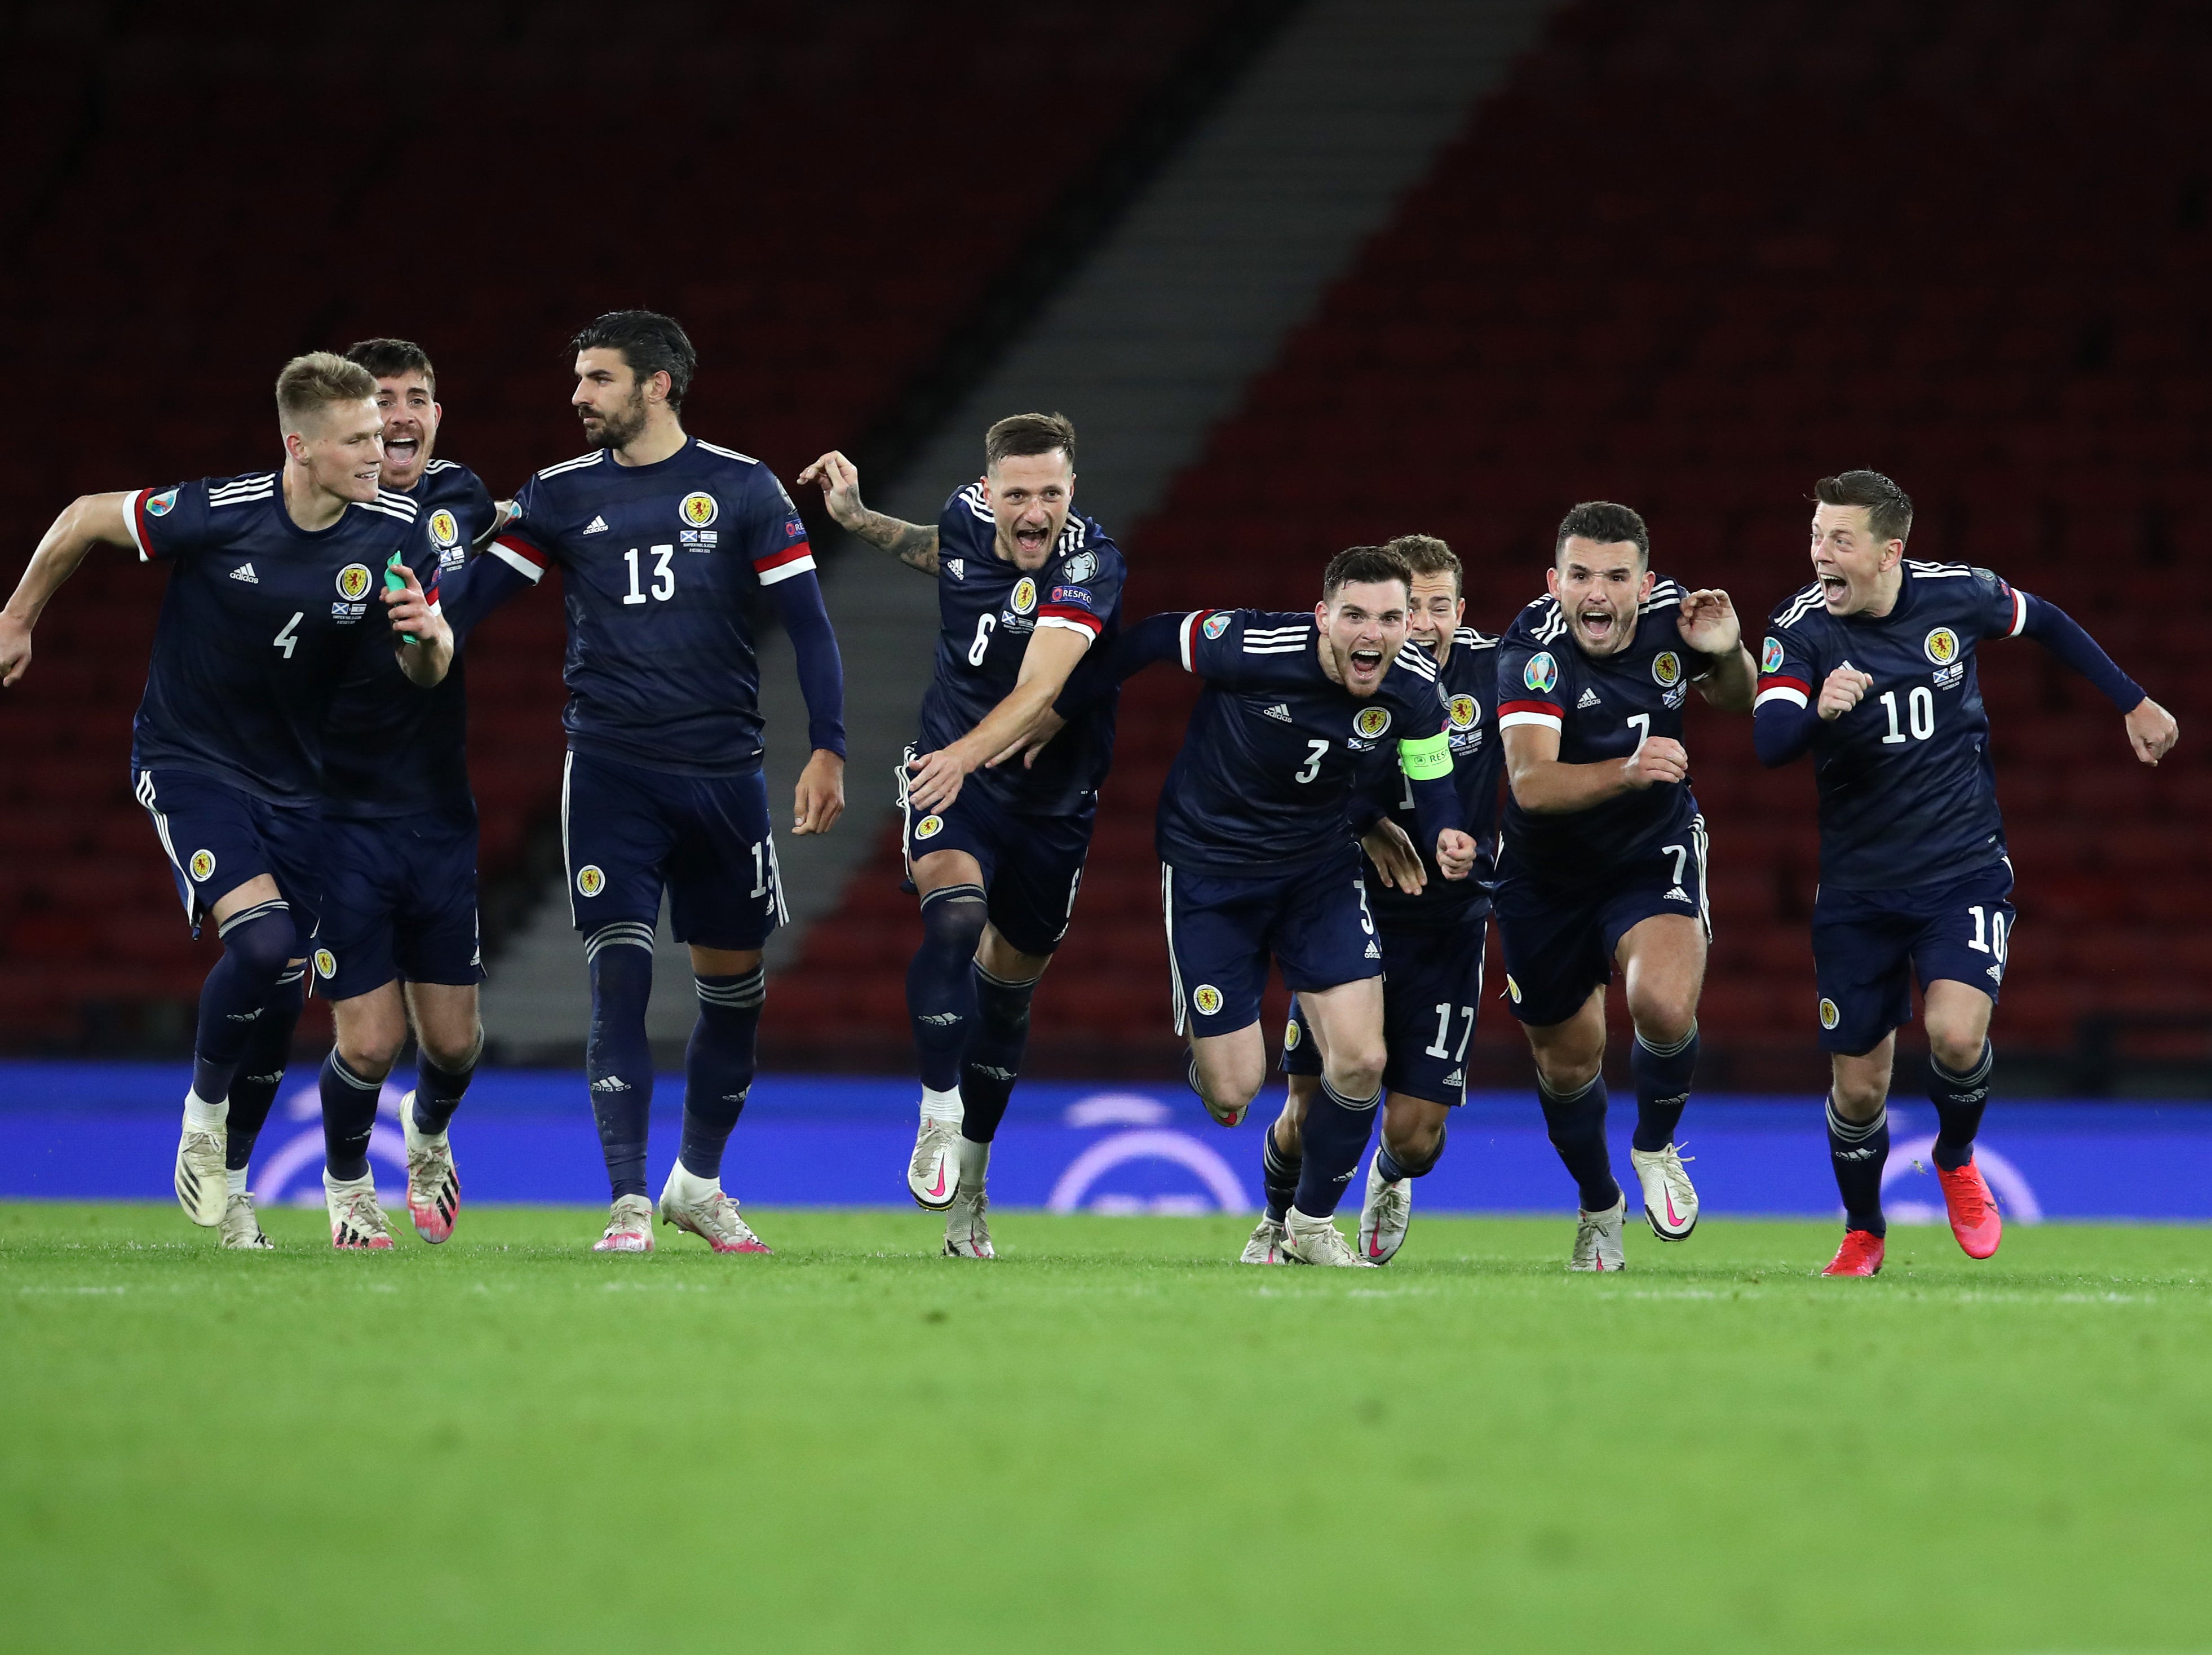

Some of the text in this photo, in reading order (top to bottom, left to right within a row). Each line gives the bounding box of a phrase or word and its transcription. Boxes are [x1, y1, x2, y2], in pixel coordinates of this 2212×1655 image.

[583, 525, 609, 535] adidas
[229, 572, 259, 584] adidas
[623, 544, 675, 605] 13
[947, 561, 964, 581] adidas
[1063, 589, 1092, 604] RESPEC
[273, 611, 304, 659] 4
[968, 613, 997, 666] 6
[1263, 709, 1292, 723] adidas
[1577, 698, 1602, 709] adidas
[1879, 686, 1935, 744] 10
[1430, 748, 1450, 763] RESP
[1627, 713, 1650, 757] 7
[1295, 739, 1330, 784] 3
[1661, 844, 1687, 884] 7
[1353, 879, 1374, 936] 3
[1664, 895, 1692, 904] adidas
[1968, 905, 2005, 963] 10
[1425, 1002, 1474, 1063] 17
